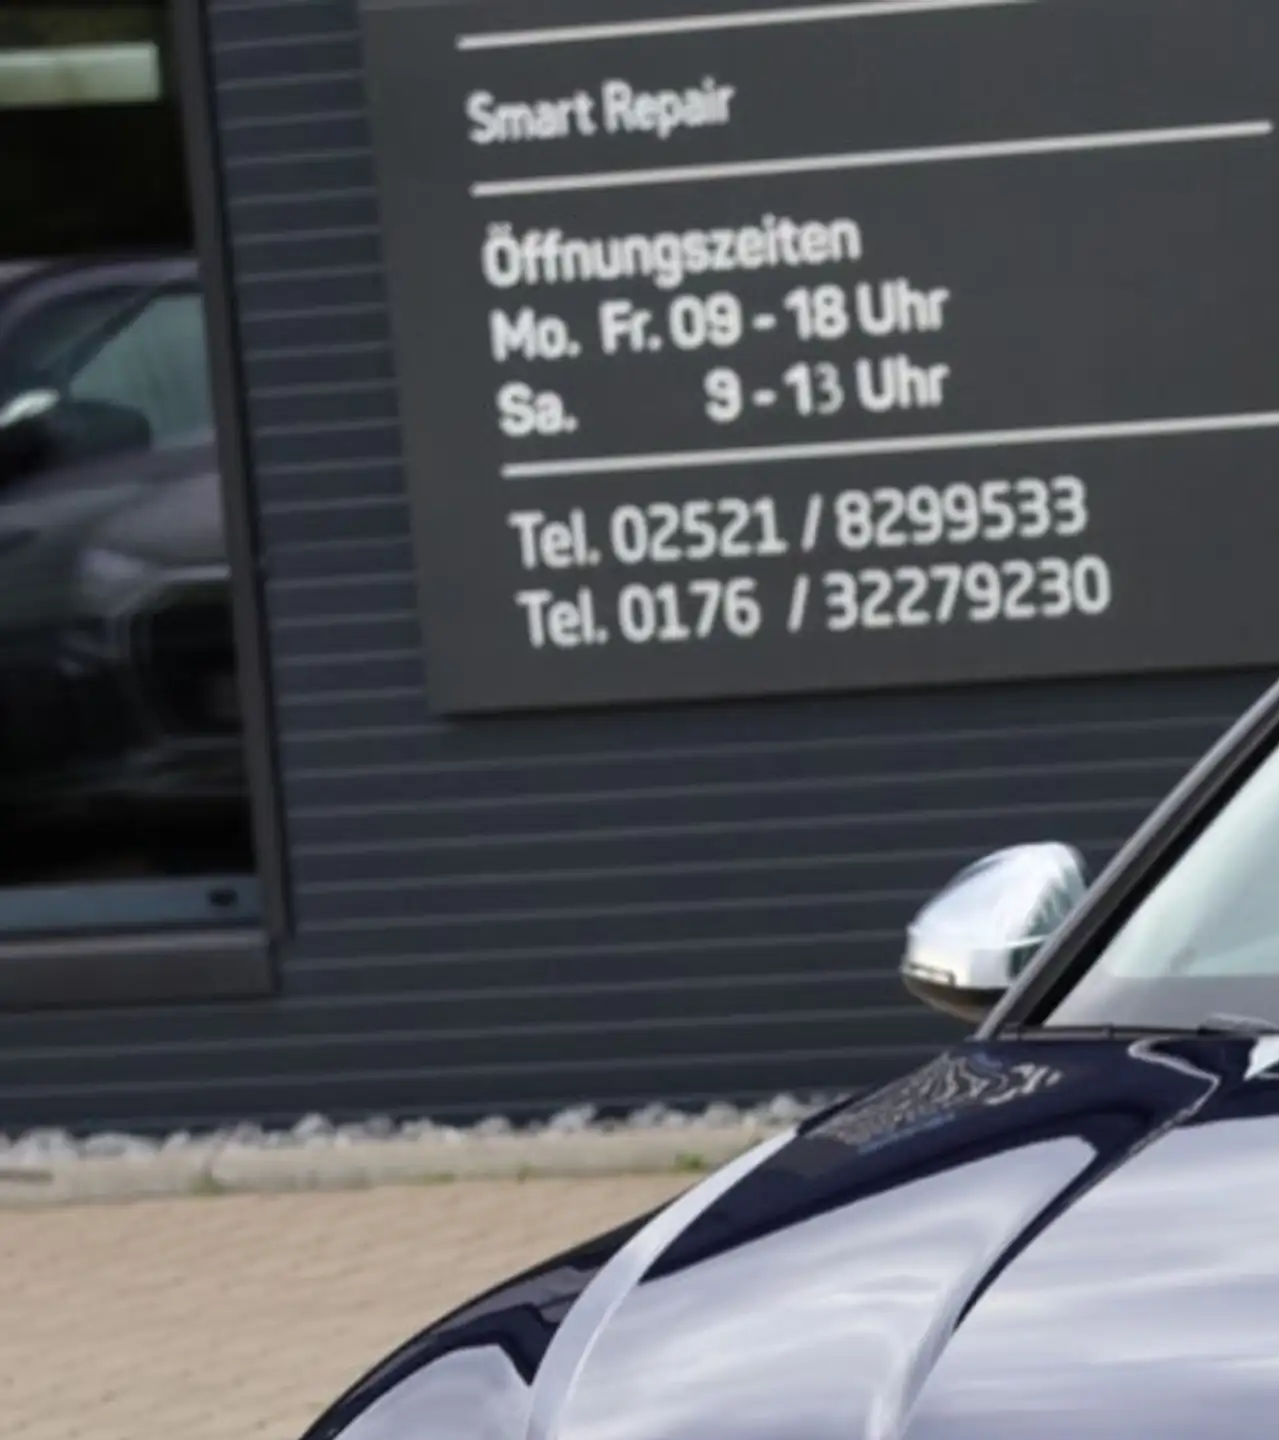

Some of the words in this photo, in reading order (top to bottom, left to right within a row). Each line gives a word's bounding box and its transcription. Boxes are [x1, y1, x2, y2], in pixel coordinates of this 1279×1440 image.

[466, 88, 597, 144] Smart
[601, 75, 736, 139] Repair
[482, 214, 862, 289] Öffnungszeiten
[489, 306, 582, 361] Mo.
[600, 300, 663, 354] Fr.
[668, 291, 742, 350] 09
[784, 283, 849, 340] 18
[855, 276, 949, 335] Uhr
[498, 381, 578, 437] Sa.
[704, 367, 743, 423] 9
[783, 361, 844, 416] 13
[855, 353, 949, 412] Uhr
[509, 507, 600, 569] Tel.
[610, 496, 789, 564] 02521
[834, 475, 1088, 550] 8299533
[516, 586, 608, 648] Tel.
[618, 576, 762, 643] 0176
[824, 554, 1111, 632] 32279230
